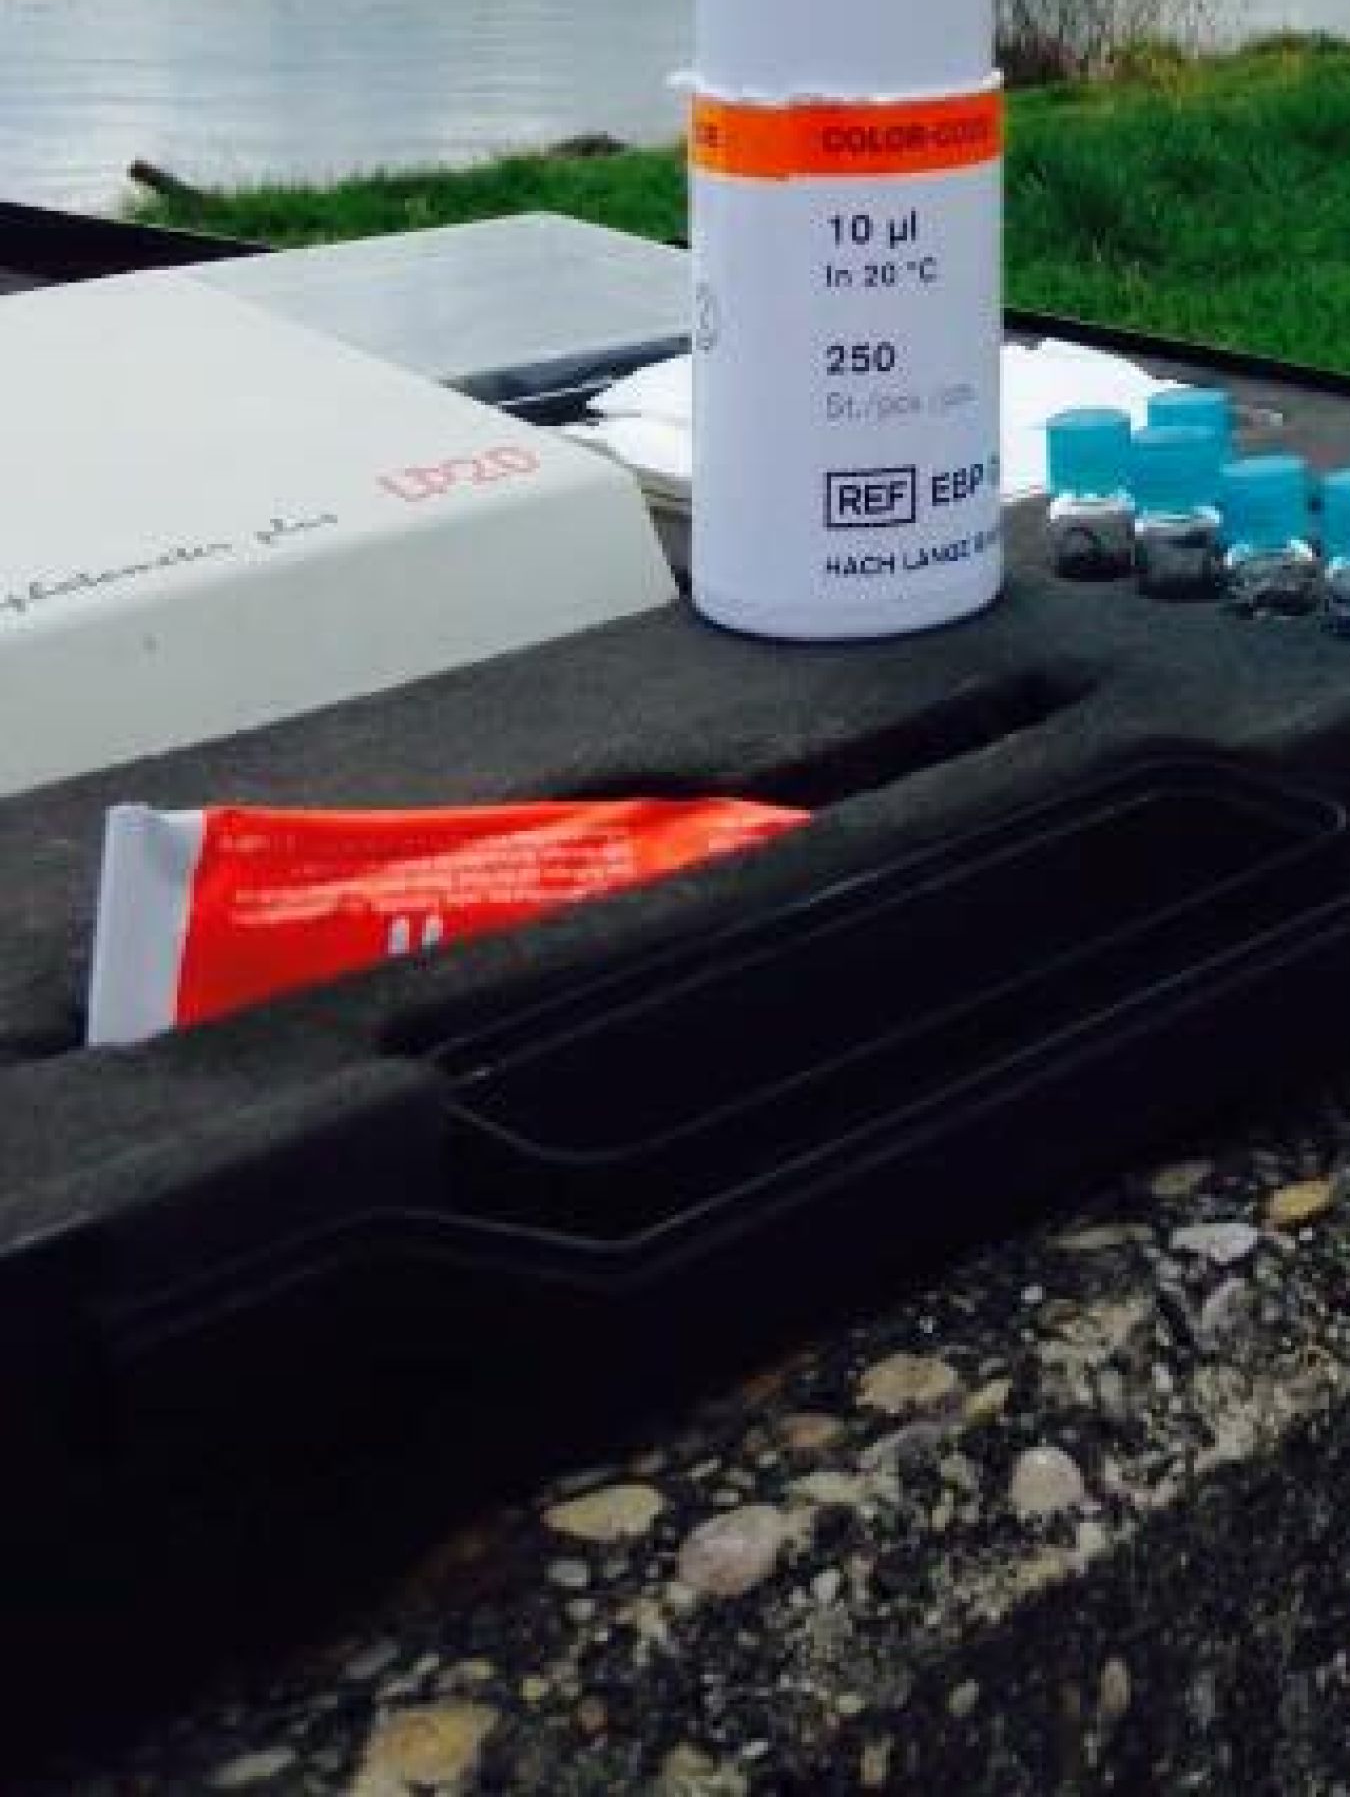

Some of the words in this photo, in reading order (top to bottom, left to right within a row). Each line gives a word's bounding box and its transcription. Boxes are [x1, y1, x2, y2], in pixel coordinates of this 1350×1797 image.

[827, 213, 871, 246] 10
[887, 208, 917, 248] µl
[864, 263, 896, 288] 20
[906, 255, 937, 284] °C
[827, 341, 895, 375] 250
[838, 479, 908, 516] REF
[826, 553, 895, 578] HACH
